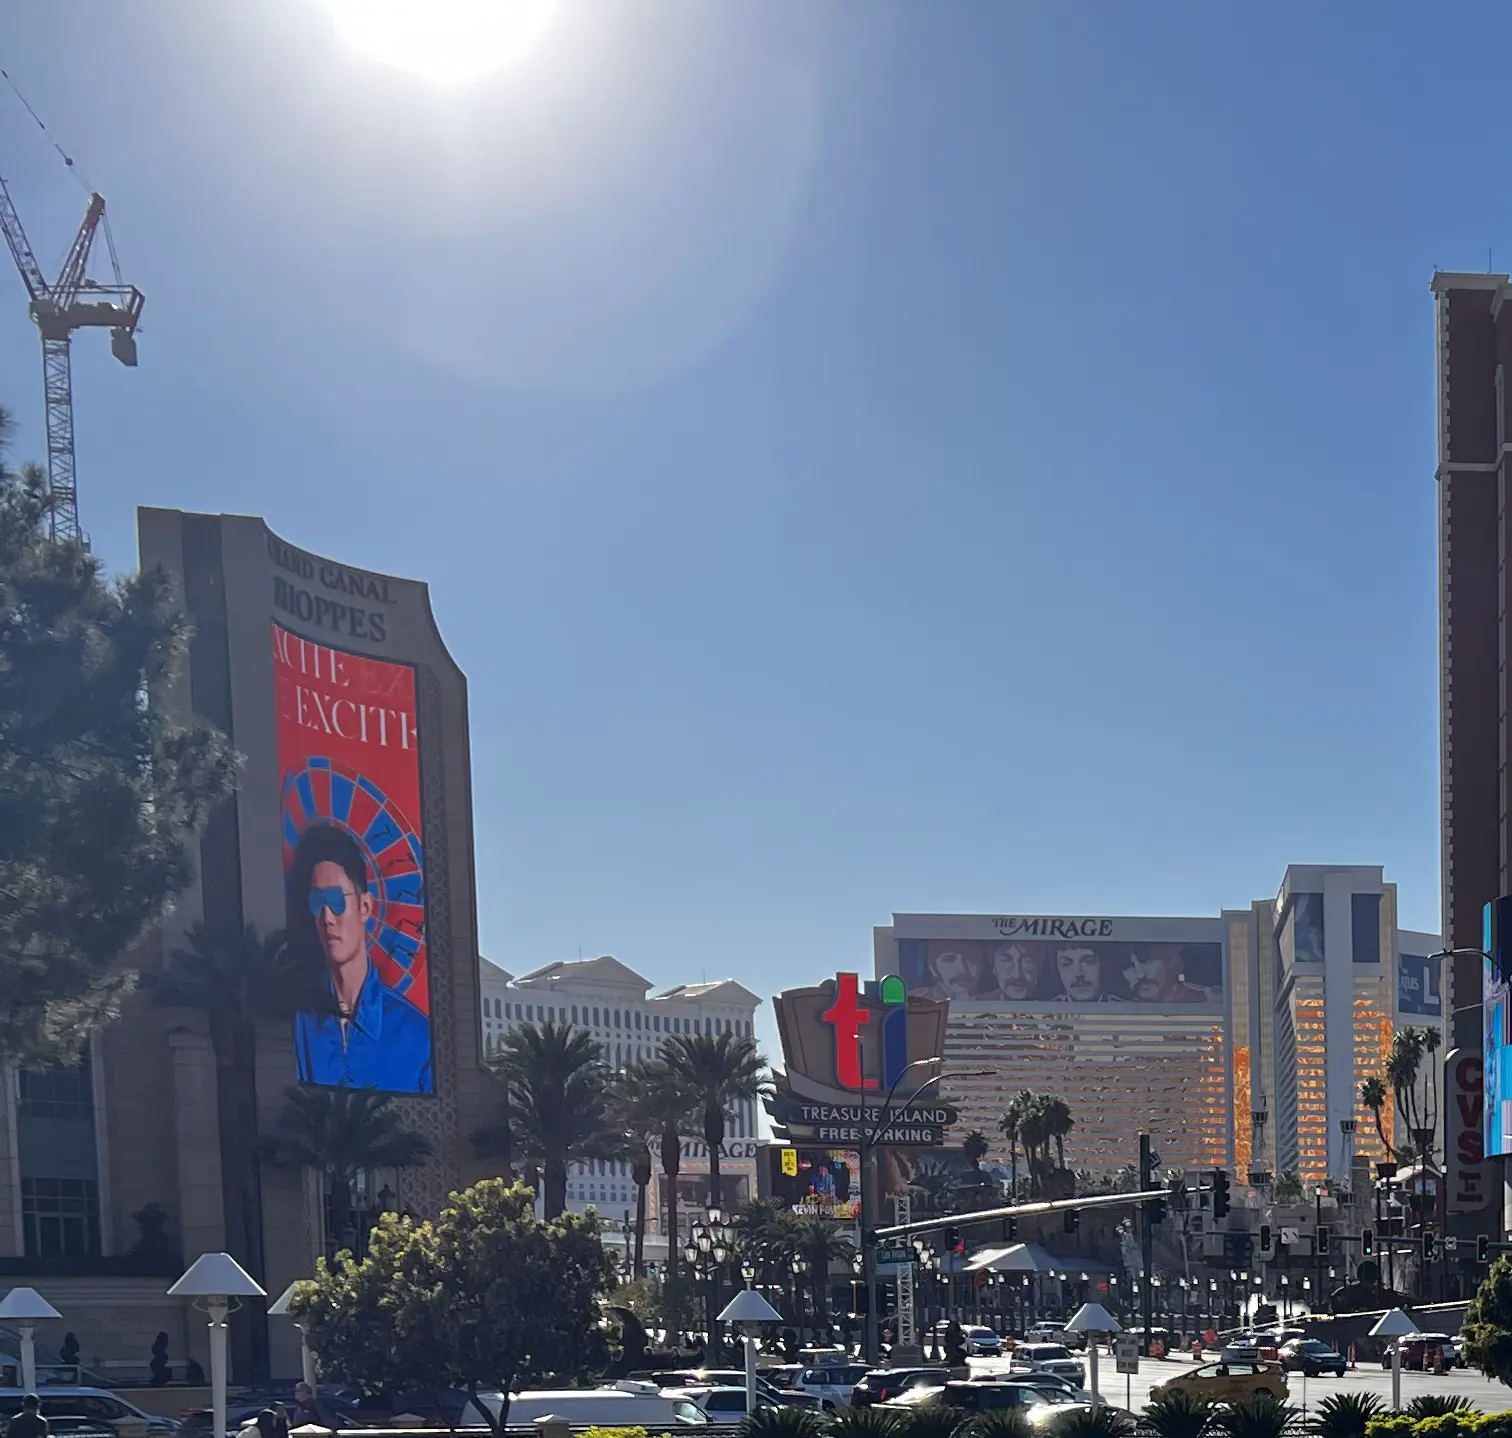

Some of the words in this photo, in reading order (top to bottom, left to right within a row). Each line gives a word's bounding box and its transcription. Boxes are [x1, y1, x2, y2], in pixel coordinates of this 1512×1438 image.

[320, 563, 397, 604] CANAL
[296, 684, 417, 750] EXCITE
[991, 917, 1017, 929] THE
[999, 918, 1113, 939] MIRAGE
[801, 1106, 880, 1121] TREASURE
[889, 1108, 947, 1123] ISLAND
[1456, 1056, 1483, 1166] CVS
[819, 1127, 860, 1140] FREE
[864, 1128, 932, 1141] PARKING
